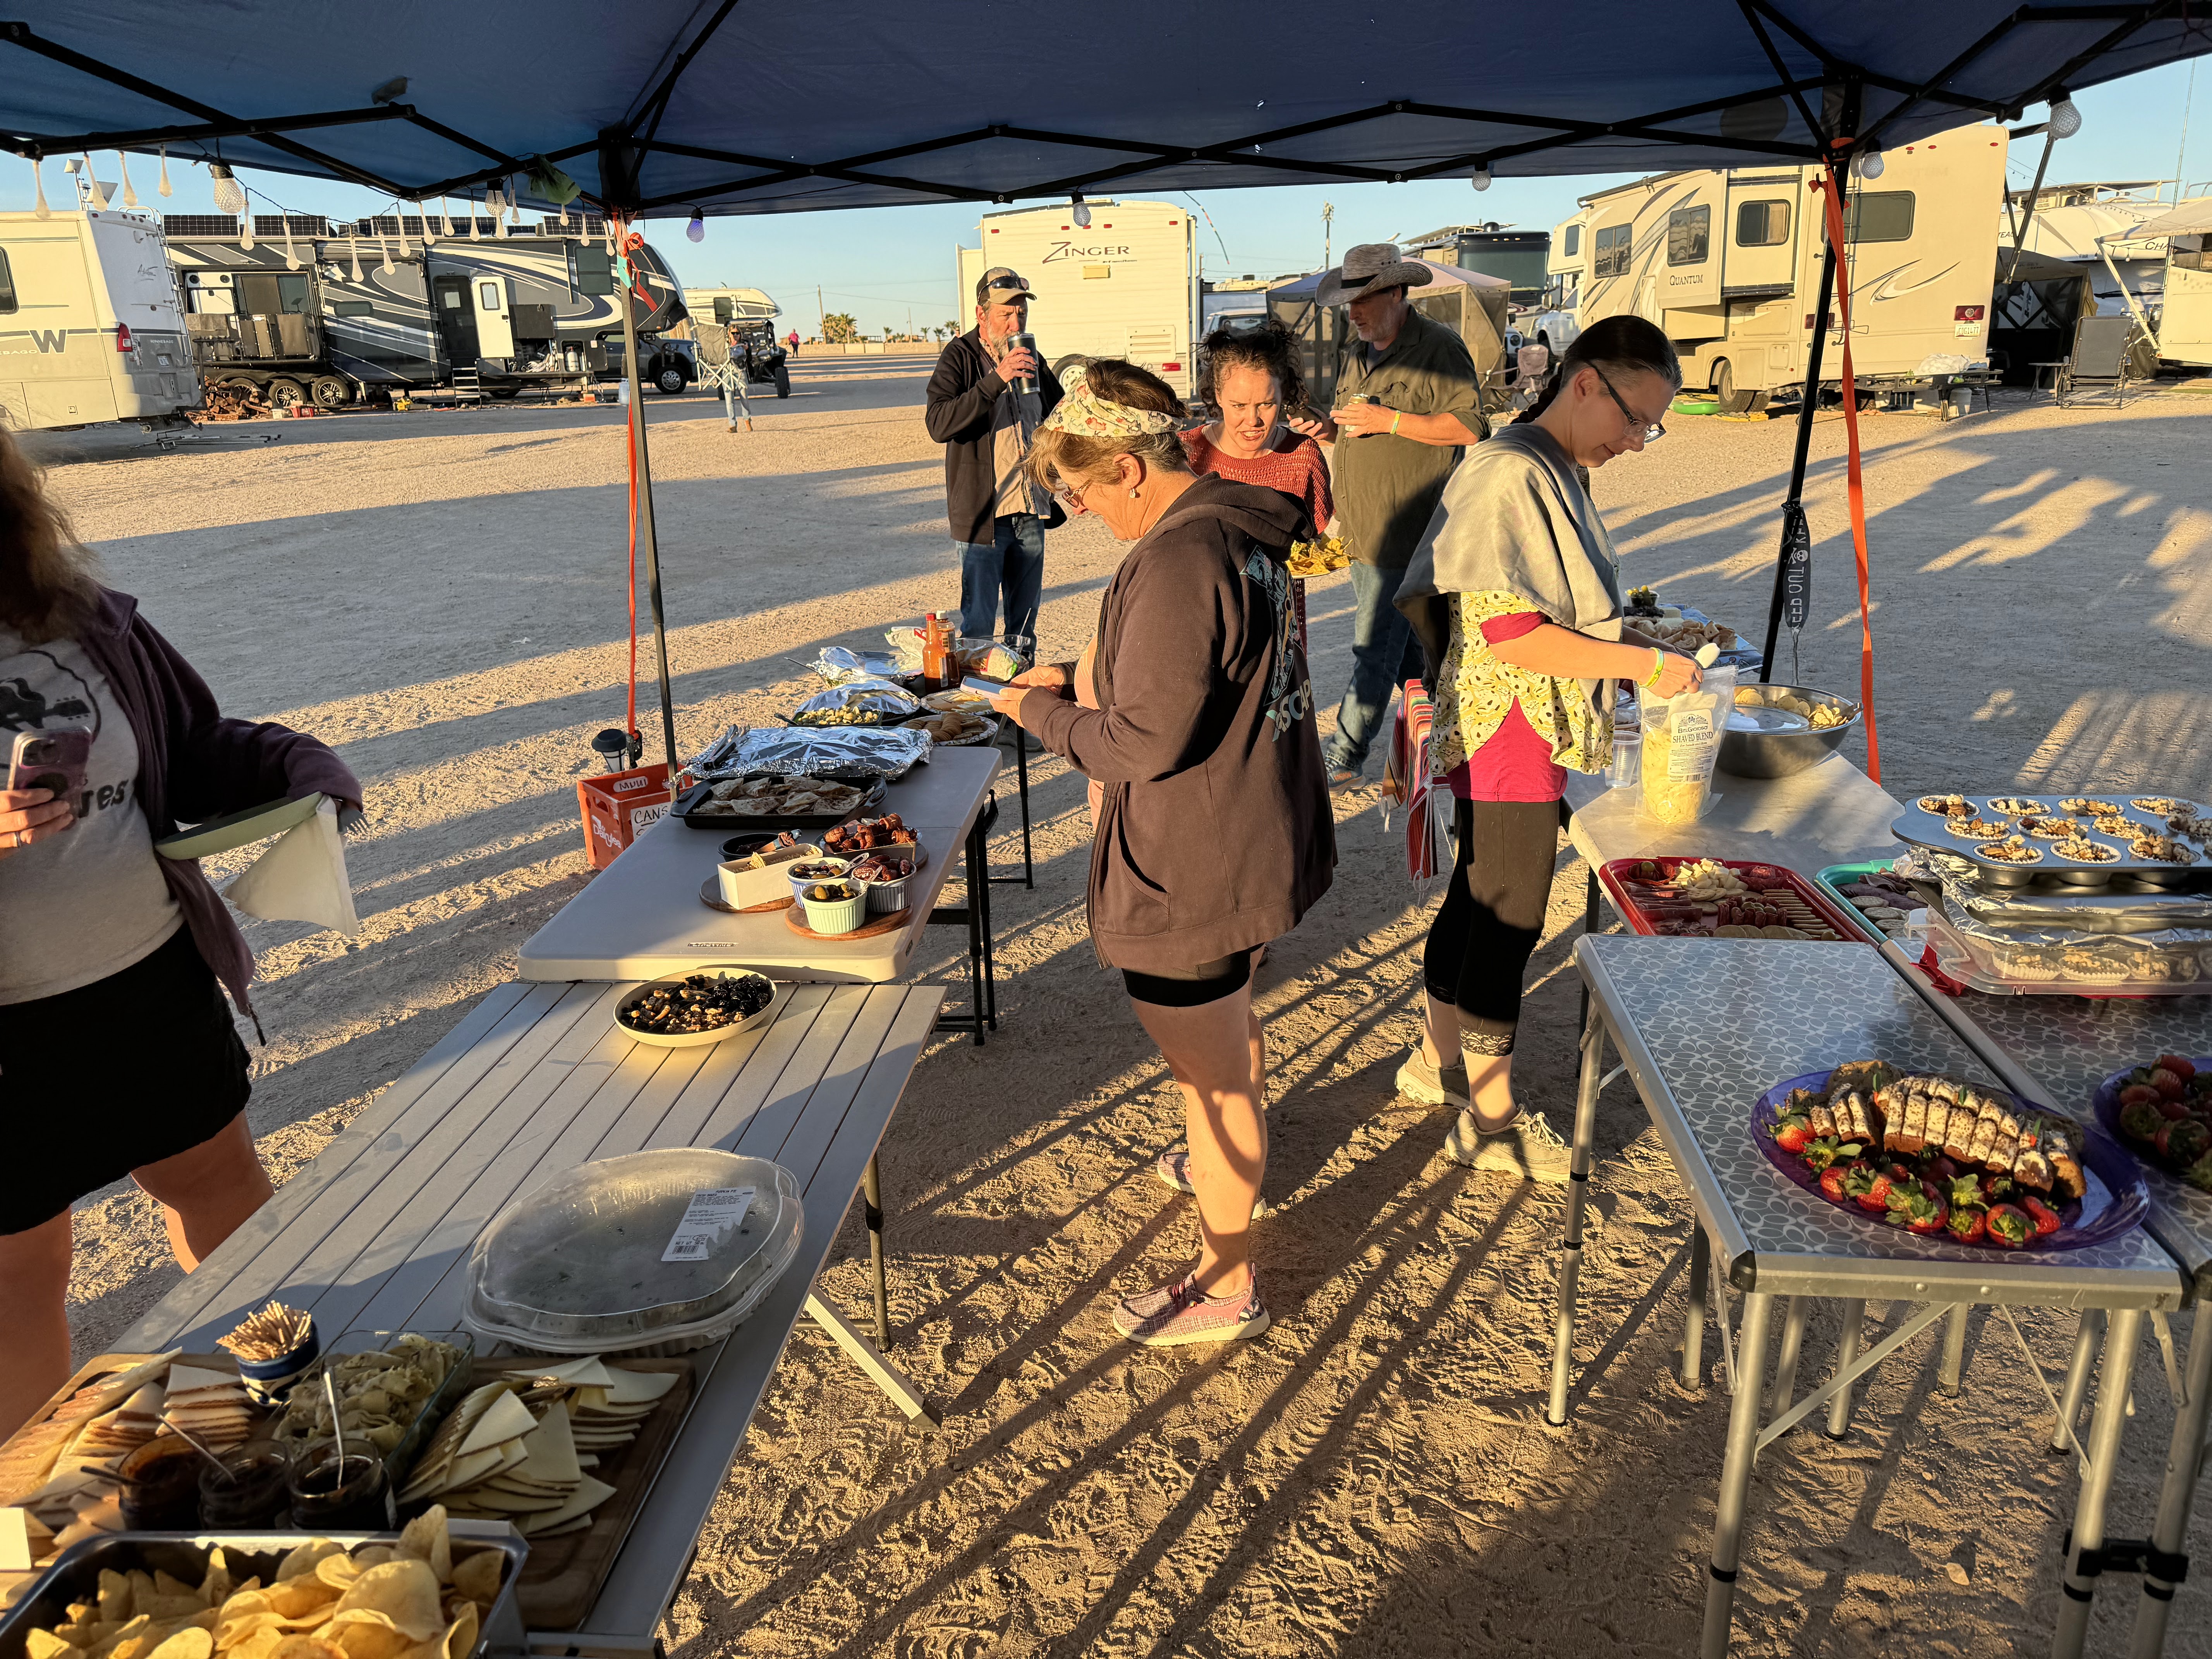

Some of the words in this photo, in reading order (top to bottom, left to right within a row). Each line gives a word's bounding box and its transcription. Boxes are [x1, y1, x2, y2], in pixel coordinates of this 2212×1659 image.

[1042, 241, 1129, 264] ZINGER
[1670, 274, 1703, 285] QUANTUM
[29, 329, 66, 353] W
[1673, 734, 1695, 743] SHAVED
[1696, 732, 1713, 741] BLEND
[78, 779, 129, 818] res
[634, 806, 668, 824] CANS
